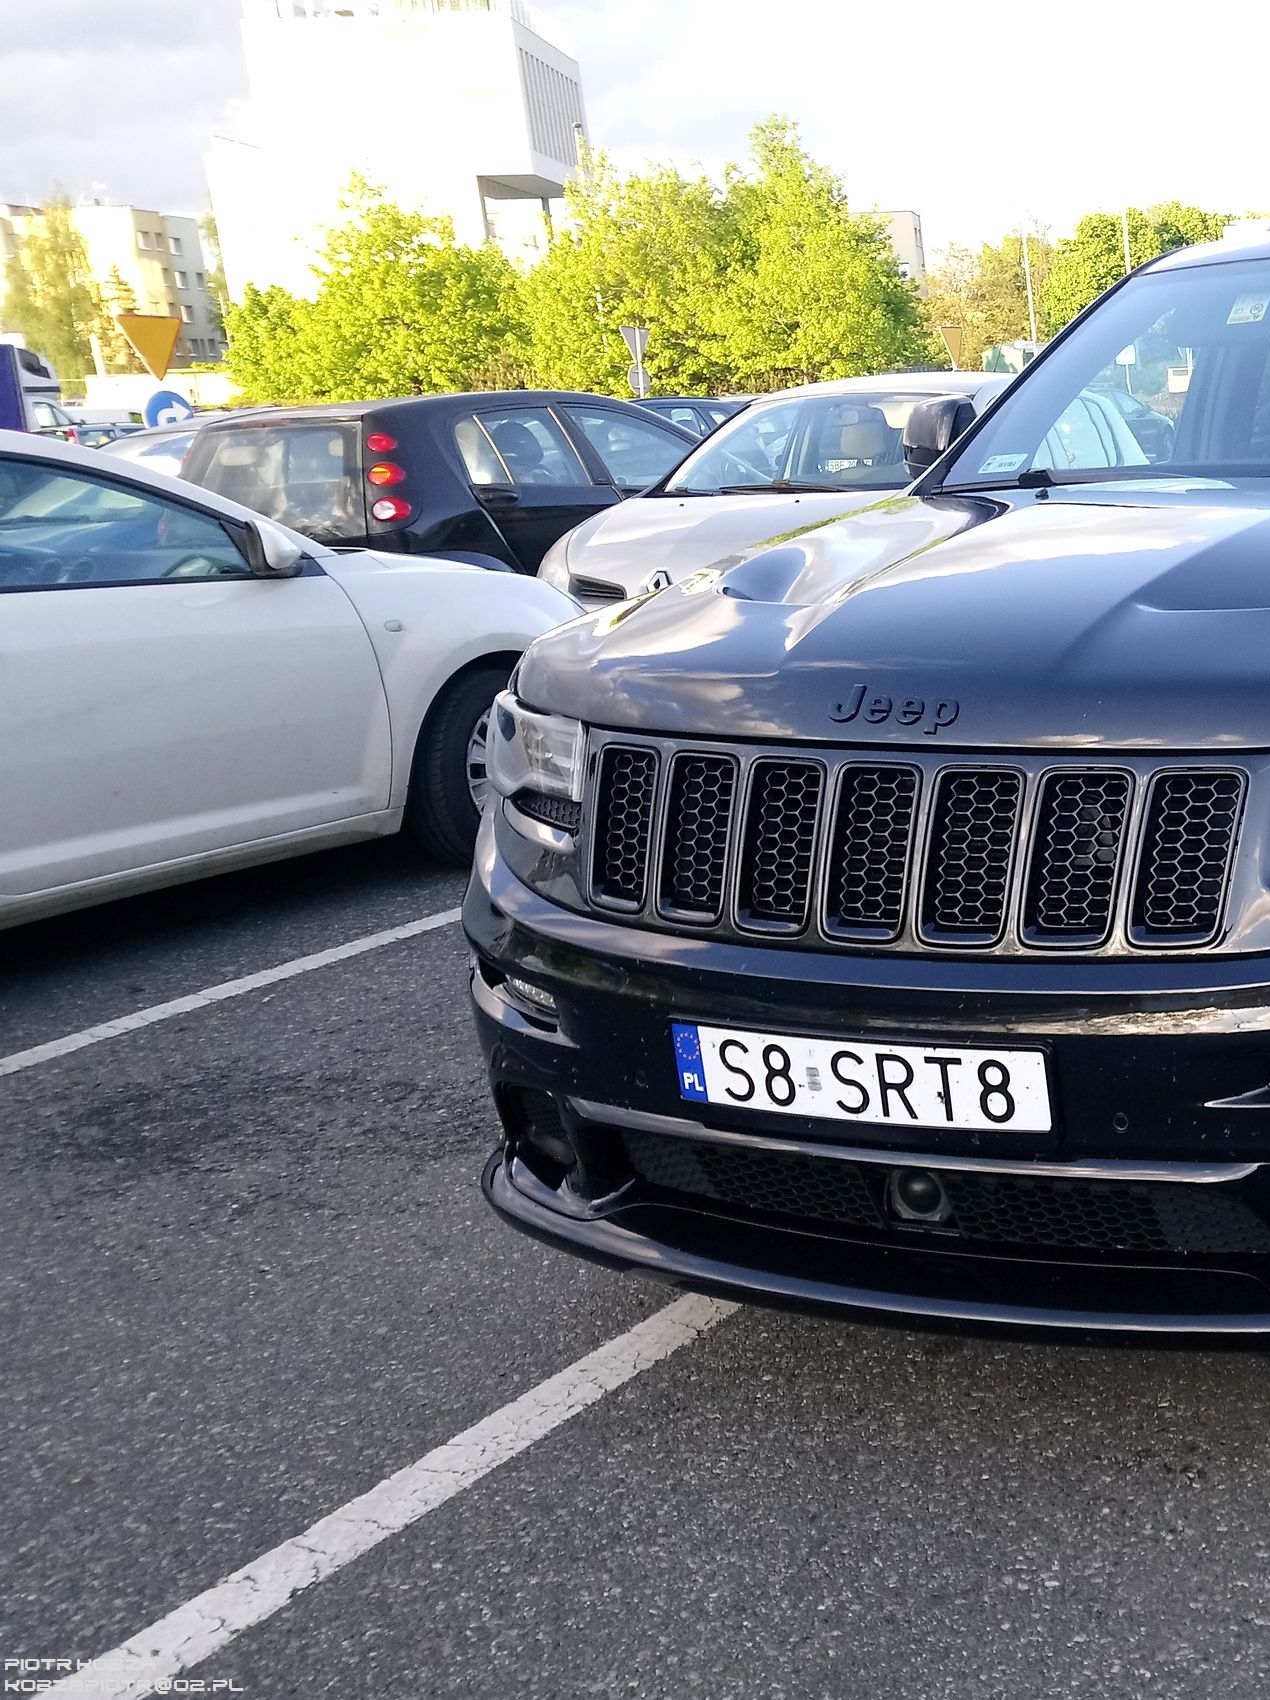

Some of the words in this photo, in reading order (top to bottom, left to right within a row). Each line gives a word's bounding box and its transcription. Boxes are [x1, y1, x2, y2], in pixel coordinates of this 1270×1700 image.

[828, 683, 960, 735] Jeep
[683, 1071, 705, 1092] PL
[718, 1039, 797, 1107] S8
[830, 1050, 1016, 1124] SRT8
